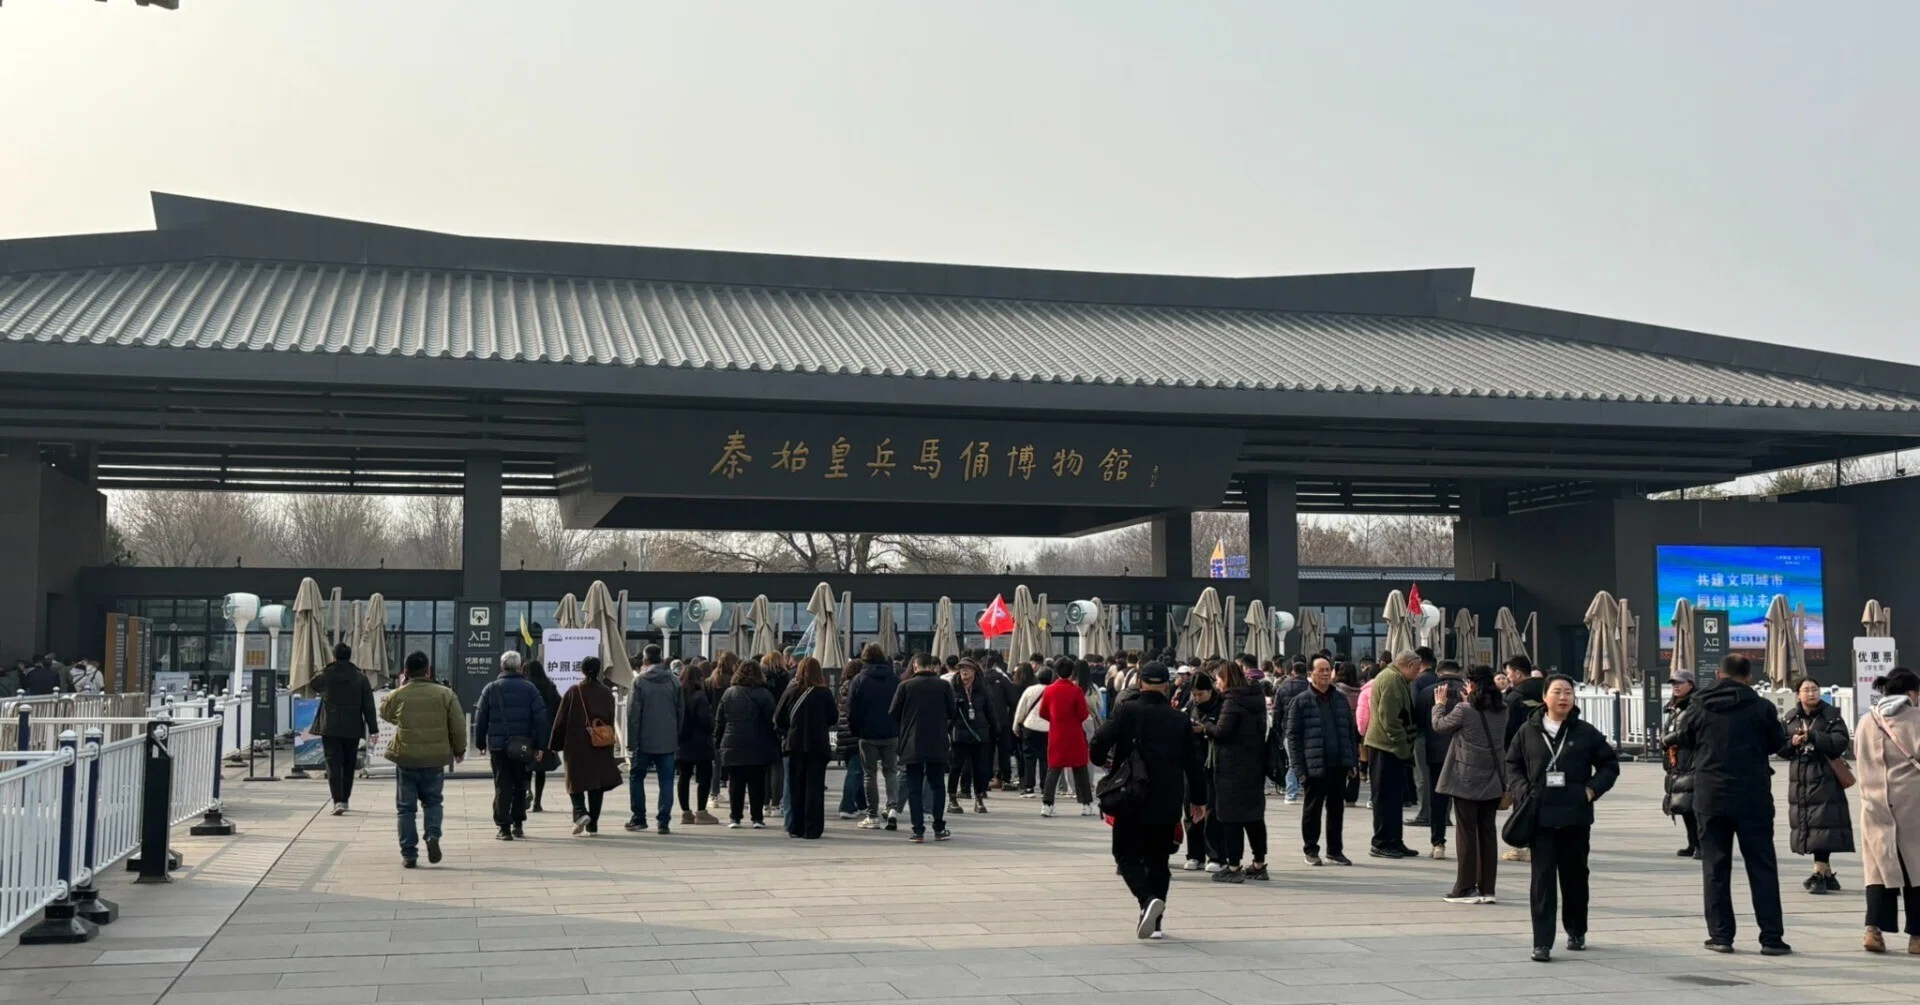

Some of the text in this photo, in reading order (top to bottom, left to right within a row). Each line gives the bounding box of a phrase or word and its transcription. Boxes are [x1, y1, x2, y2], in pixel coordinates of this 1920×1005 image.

[710, 431, 1133, 482] 秦始皇兵馬俑博物館
[1696, 572, 1784, 587] 共建文明城市
[1697, 593, 1779, 609] 同创美好未
[468, 630, 491, 641] 入口
[1703, 637, 1720, 647] 入口
[1858, 651, 1892, 663] 优惠票
[547, 660, 584, 672] 护照通
